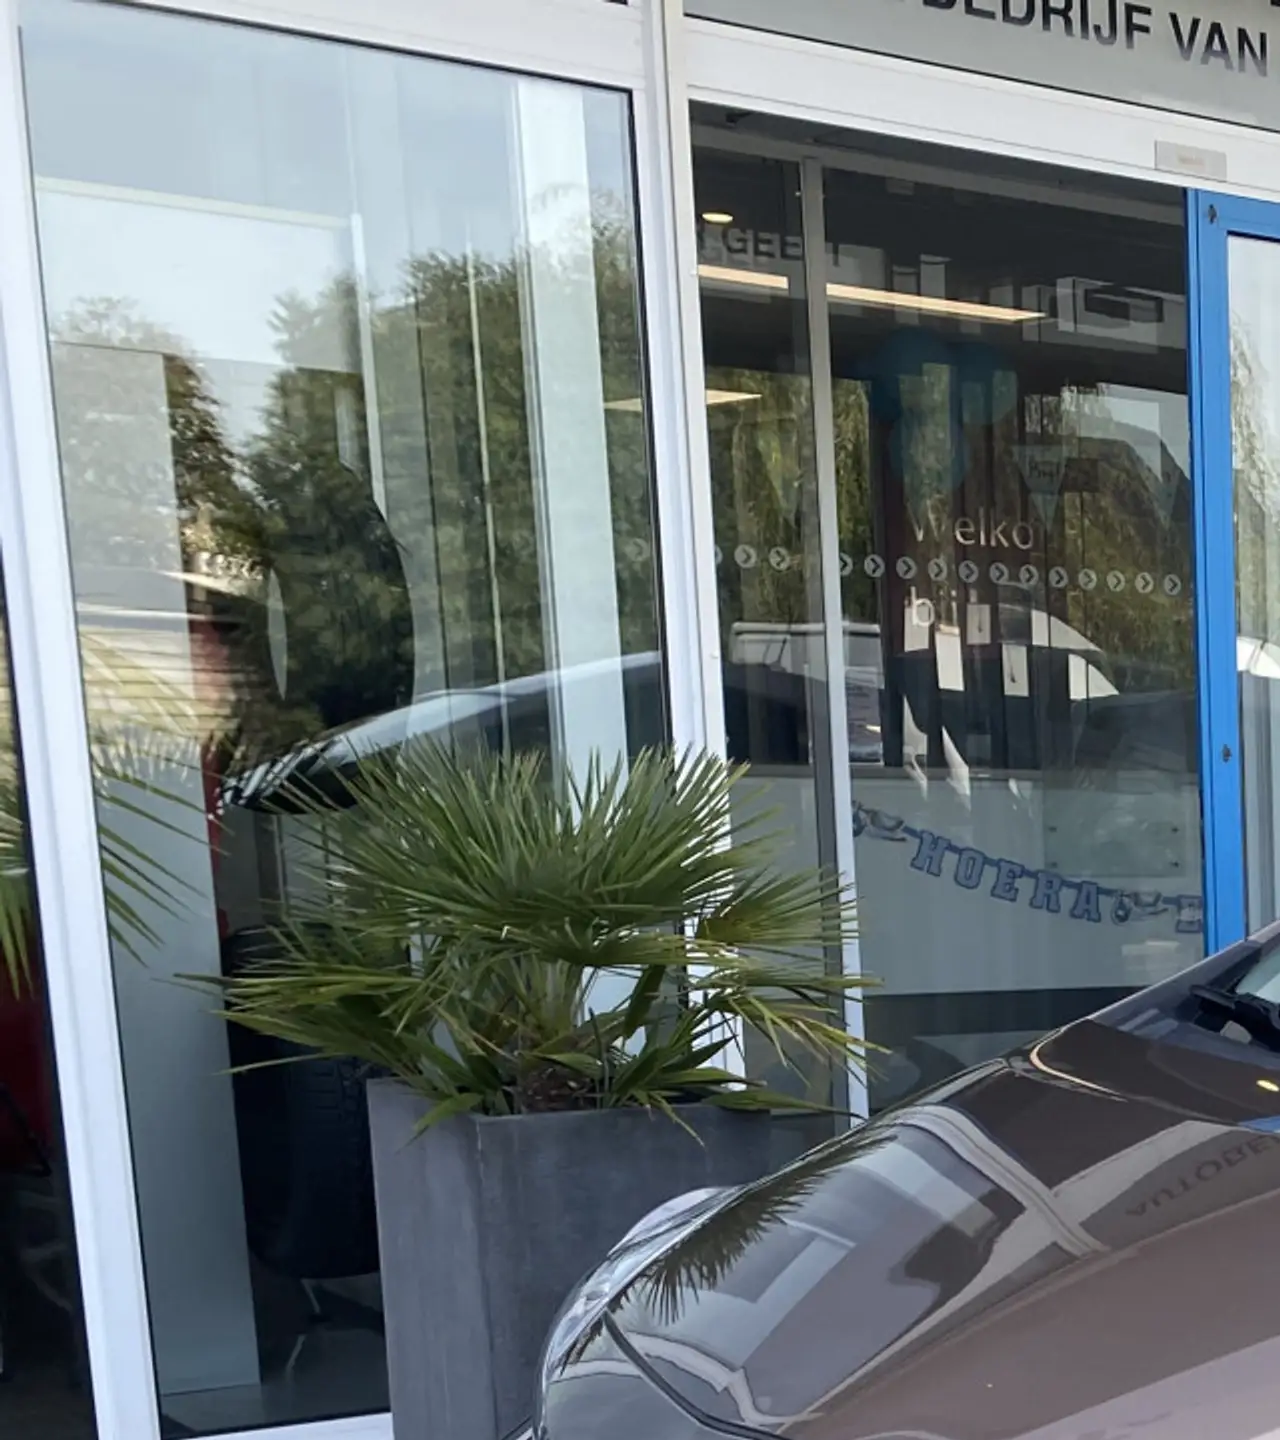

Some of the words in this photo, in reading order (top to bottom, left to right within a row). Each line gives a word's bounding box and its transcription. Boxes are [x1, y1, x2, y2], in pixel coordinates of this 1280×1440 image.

[922, 0, 1153, 49] DRIJF
[1168, 12, 1267, 77] VAN
[911, 831, 1101, 923] HOERA
